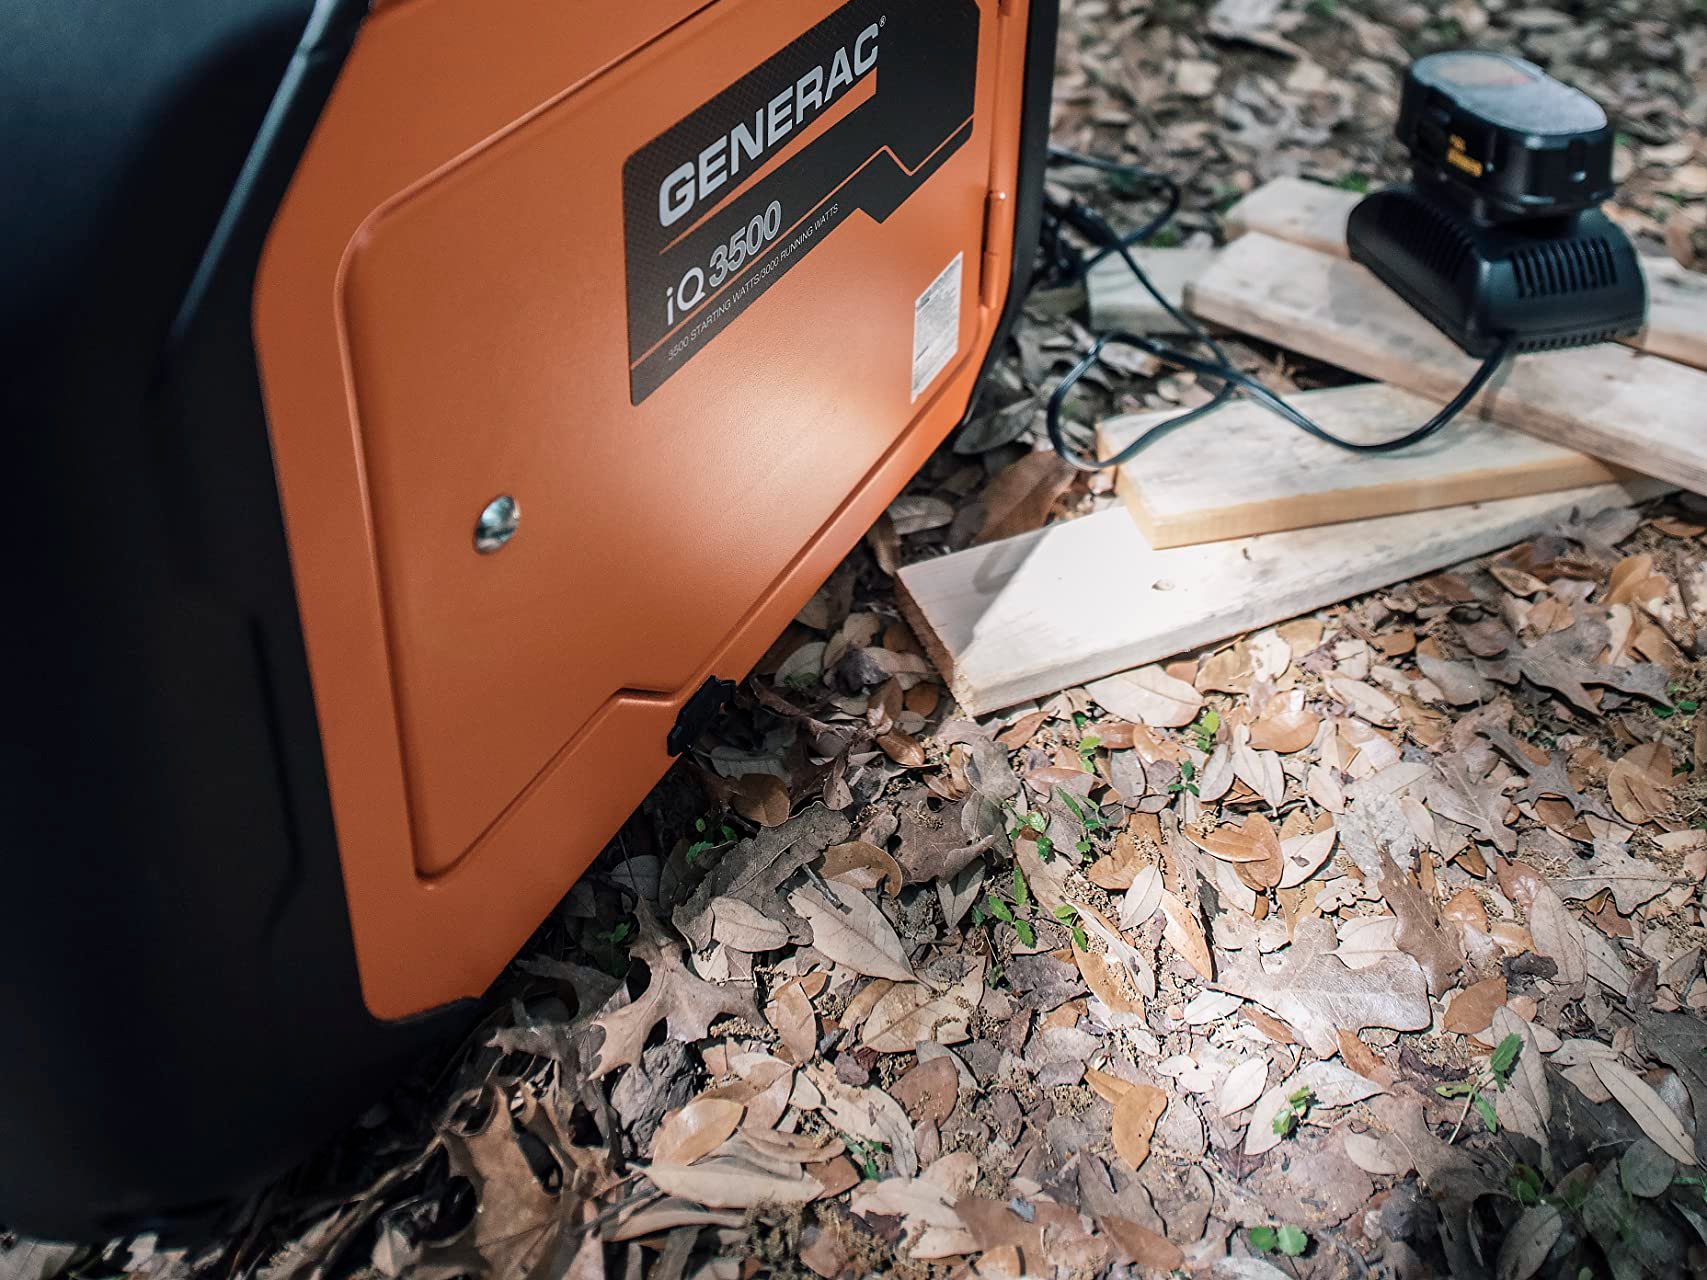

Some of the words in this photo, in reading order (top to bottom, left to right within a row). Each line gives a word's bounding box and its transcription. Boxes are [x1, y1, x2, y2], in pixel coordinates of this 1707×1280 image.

[666, 267, 706, 326] iQ
[709, 200, 782, 287] 3500
[668, 337, 689, 361] 3500
[690, 298, 732, 341] STARTING
[732, 256, 779, 303] WATTS/3000
[780, 228, 813, 260] RUNNING
[814, 203, 840, 231] WATTS
